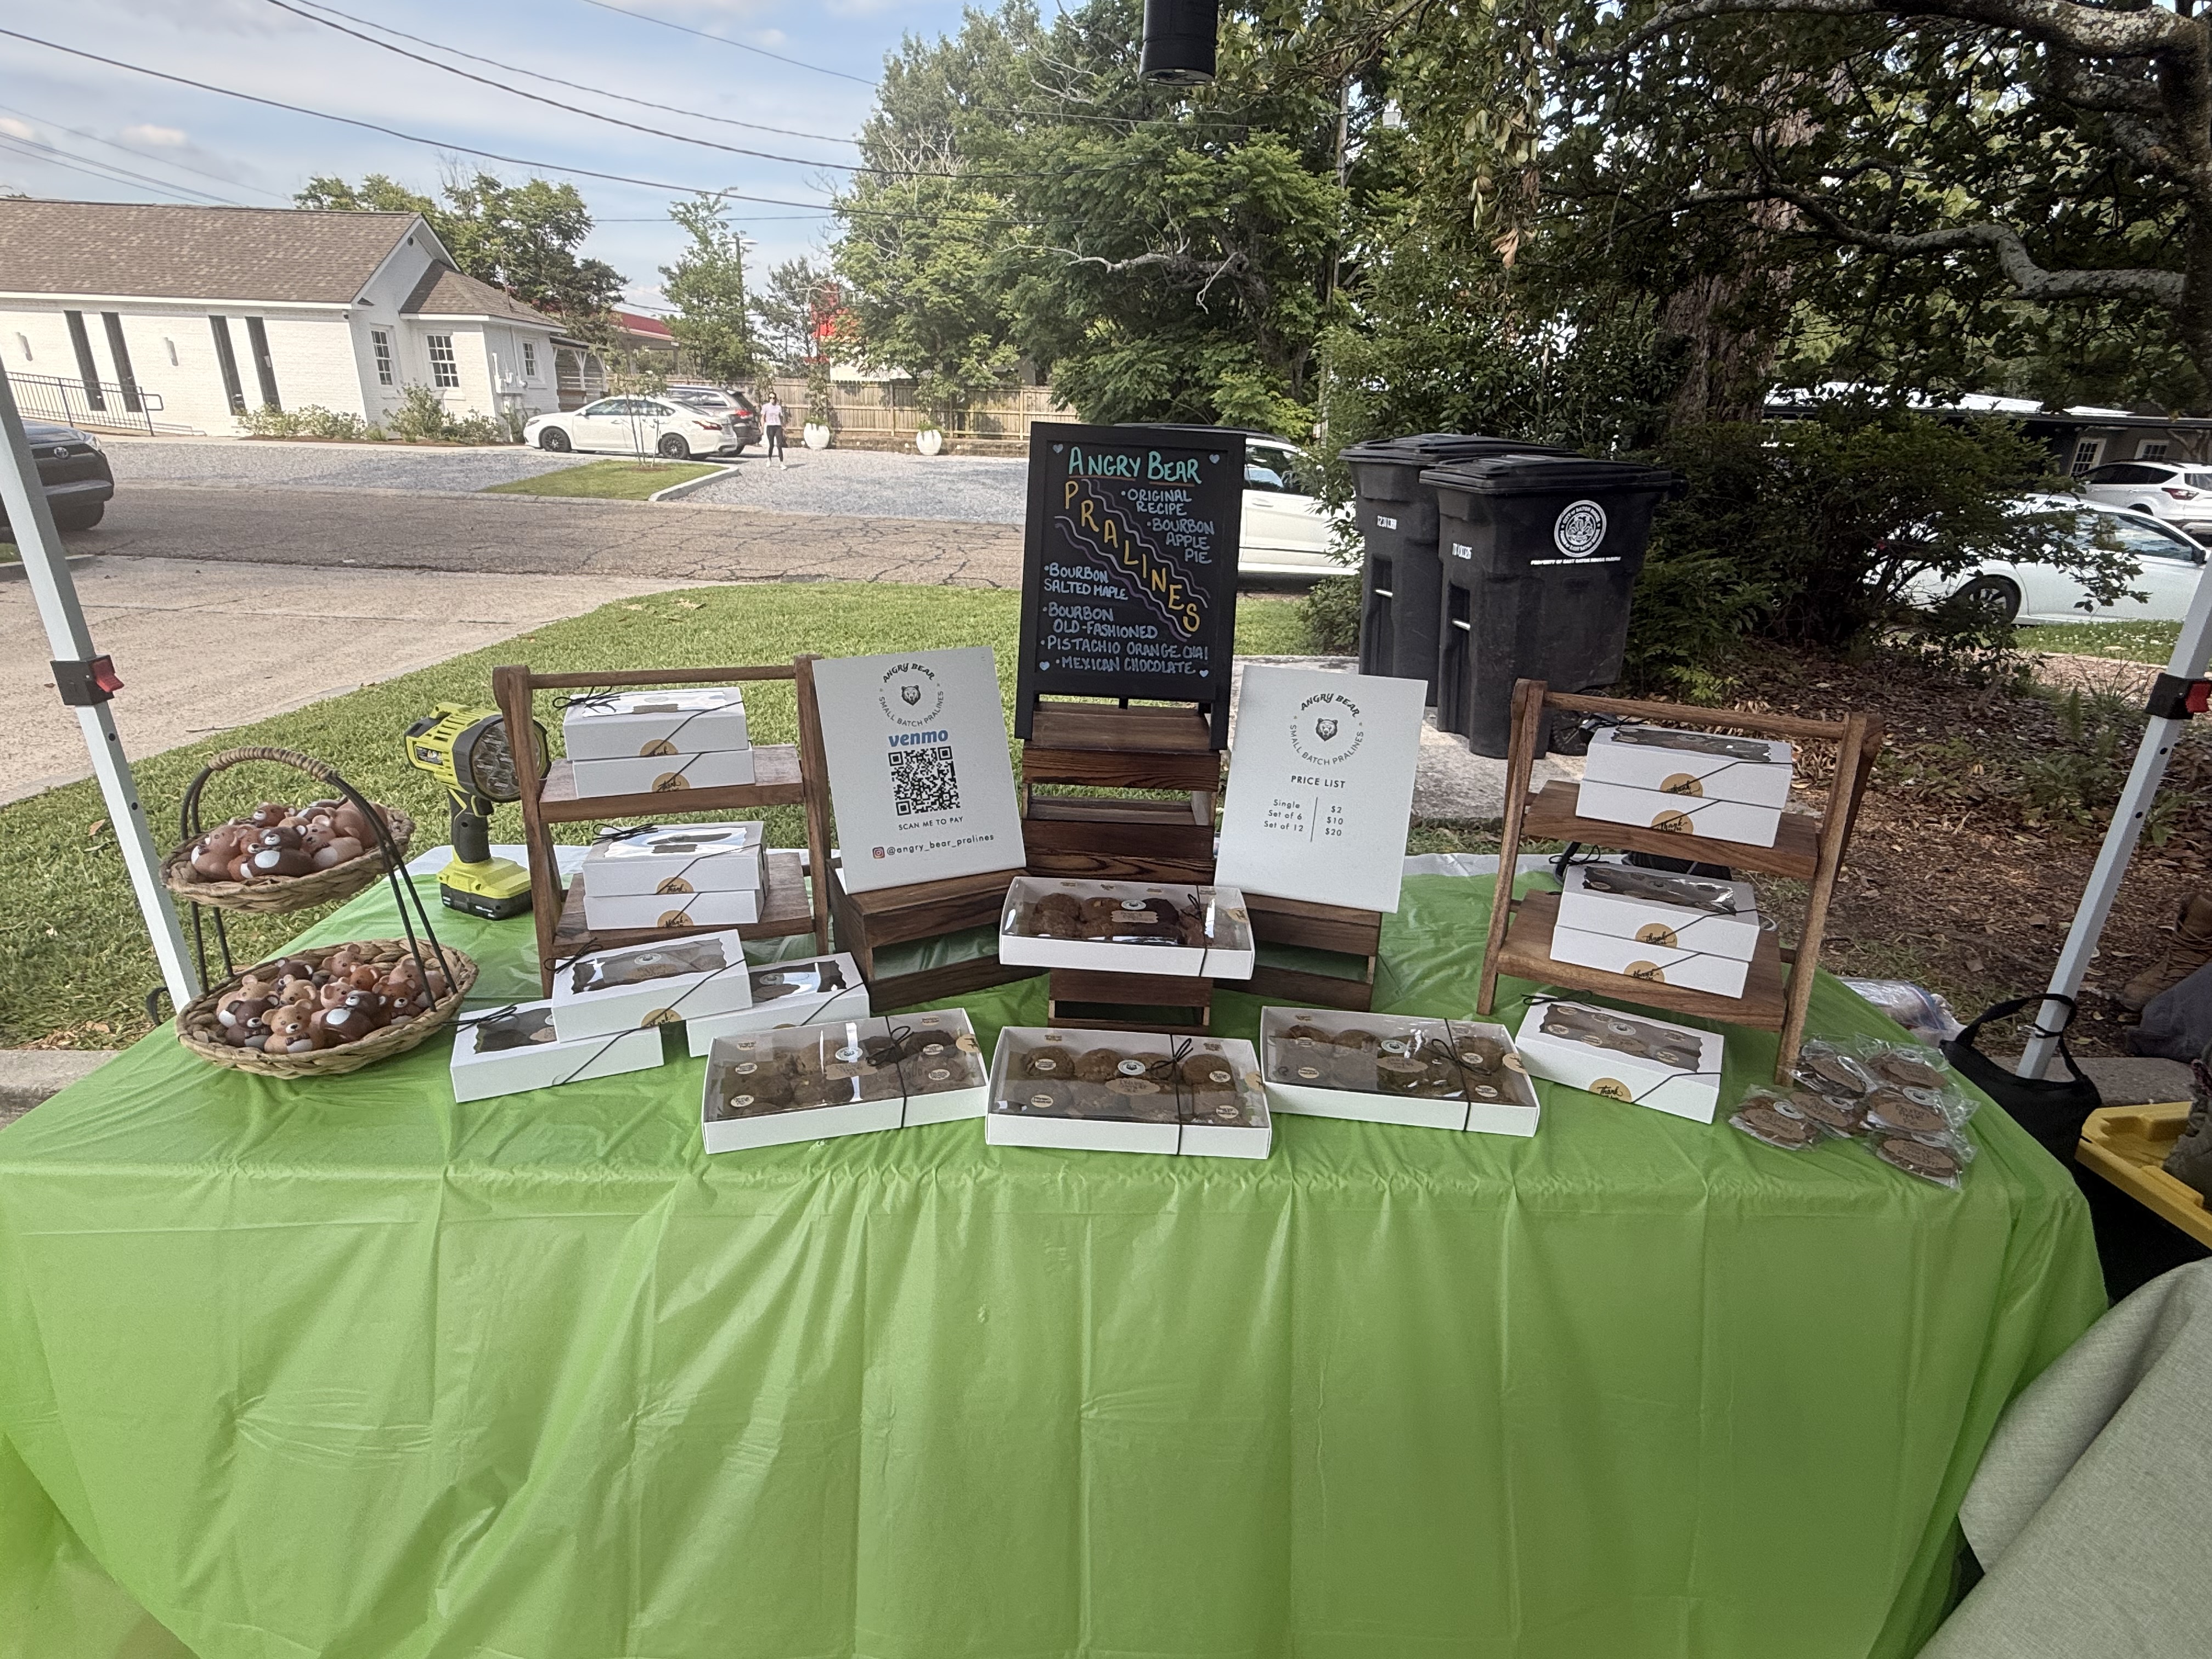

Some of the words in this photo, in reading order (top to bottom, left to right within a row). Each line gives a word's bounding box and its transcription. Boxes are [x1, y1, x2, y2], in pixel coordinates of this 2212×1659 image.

[1069, 446, 1141, 477] ANGRY
[1148, 451, 1202, 484] BEAR
[1127, 489, 1192, 501] ORIGINAL
[1136, 501, 1187, 515] RECIPE
[1153, 518, 1215, 534] BOURBON
[1166, 532, 1210, 549] APPLE
[1065, 481, 1201, 632] PRALINES
[1184, 549, 1212, 564] PIE
[1049, 564, 1108, 583] BOURBON
[1044, 578, 1091, 595] SALTED
[1093, 585, 1128, 600] MAPLE
[1048, 602, 1114, 621] BOURBON
[1053, 619, 1158, 639] OLD-FASHIONED
[1047, 637, 1121, 654] PISTACHIO
[1126, 641, 1181, 658] ORANGE
[1183, 646, 1208, 660] CHAI
[883, 663, 909, 683] ANGRY
[911, 663, 935, 680] BEAR
[1062, 657, 1120, 672] MEXICAN
[1124, 658, 1196, 675] CHOCOLATE
[879, 697, 895, 721] SMALL
[897, 718, 923, 727] BATCH
[924, 691, 944, 724] PRALINES
[1301, 693, 1334, 710] ANGRY
[1335, 695, 1360, 718] BEAR
[888, 730, 949, 747] venmo
[1290, 725, 1302, 753] SMALL
[1302, 752, 1330, 765] BATCH
[1333, 731, 1364, 764] PRALINES
[1291, 775, 1320, 786] PRICE
[1324, 779, 1345, 788] LIST
[1273, 799, 1300, 809] Single
[1331, 805, 1342, 814] $2
[899, 822, 919, 831] SCAN
[1327, 816, 1344, 825] $10
[1325, 828, 1342, 836] $20
[887, 834, 994, 856] @angry_bear_pralines
[1597, 1085, 1623, 1097] Thank
